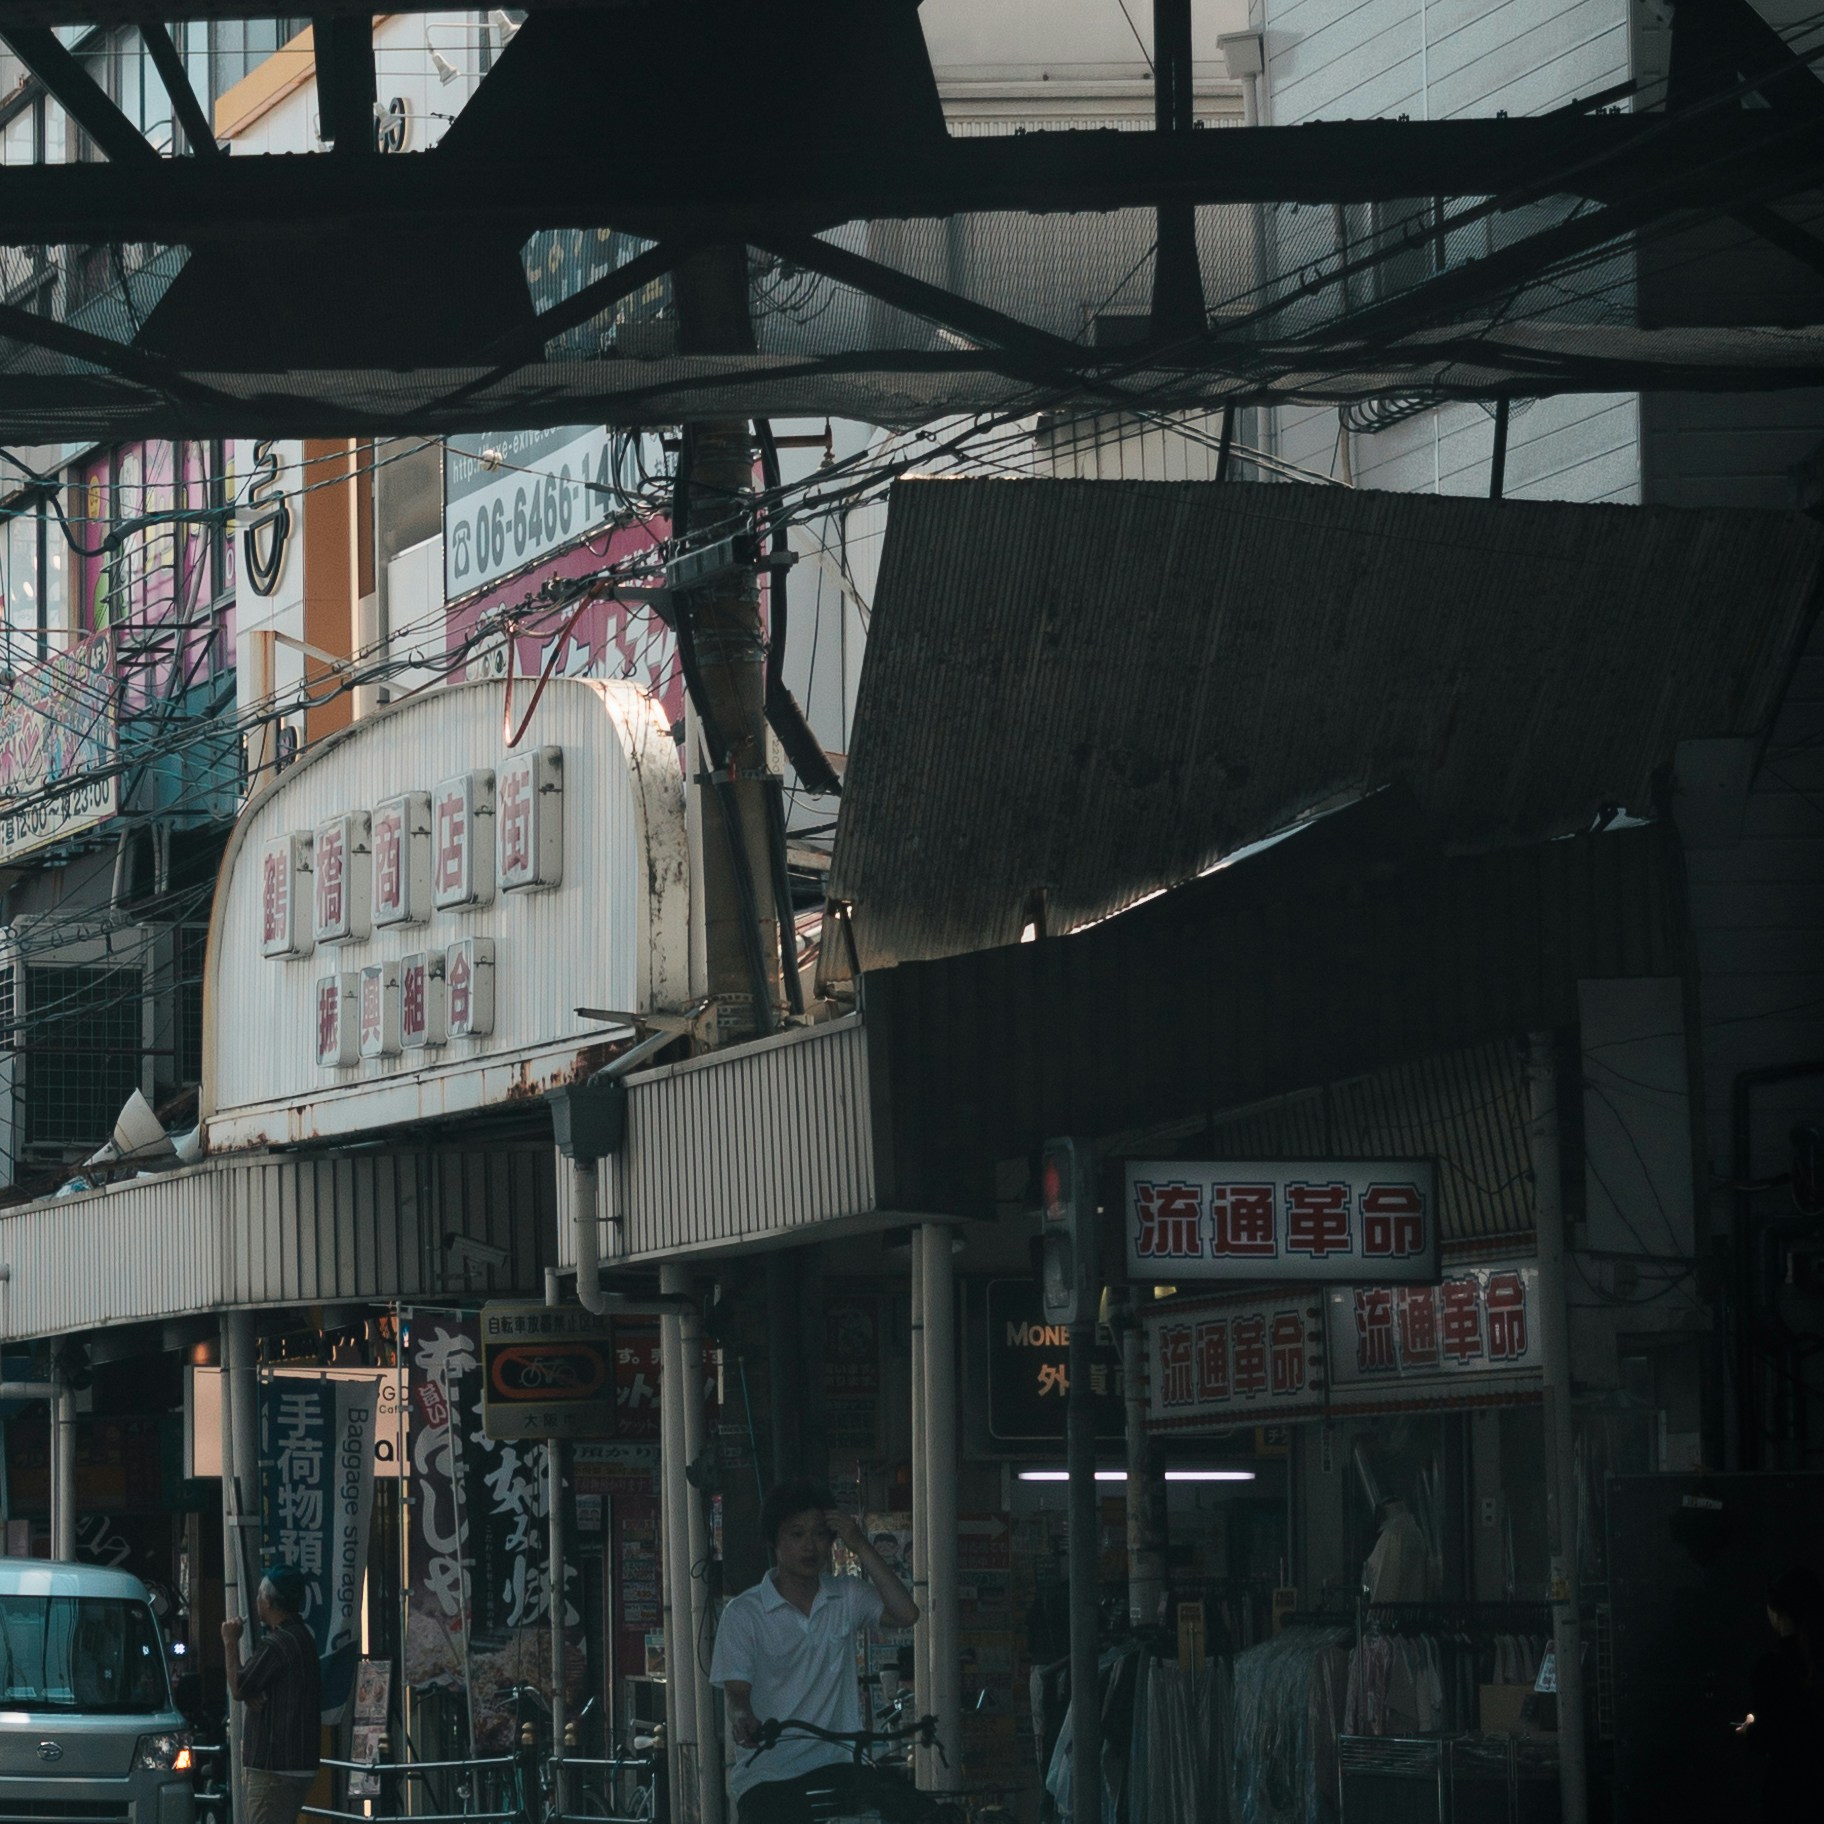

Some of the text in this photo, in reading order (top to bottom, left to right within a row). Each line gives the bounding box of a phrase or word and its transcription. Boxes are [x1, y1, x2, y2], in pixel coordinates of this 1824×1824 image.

[263, 770, 531, 947] 鶴橋商店街
[318, 952, 471, 1056] 振興組合
[1135, 1180, 1426, 1259] 流通革命
[1006, 1321, 1072, 1347] MONE
[1160, 1310, 1305, 1408] 流通革命
[1355, 1270, 1528, 1372] 流通革命
[341, 1406, 369, 1517] Baggage
[339, 1527, 361, 1619] storage
